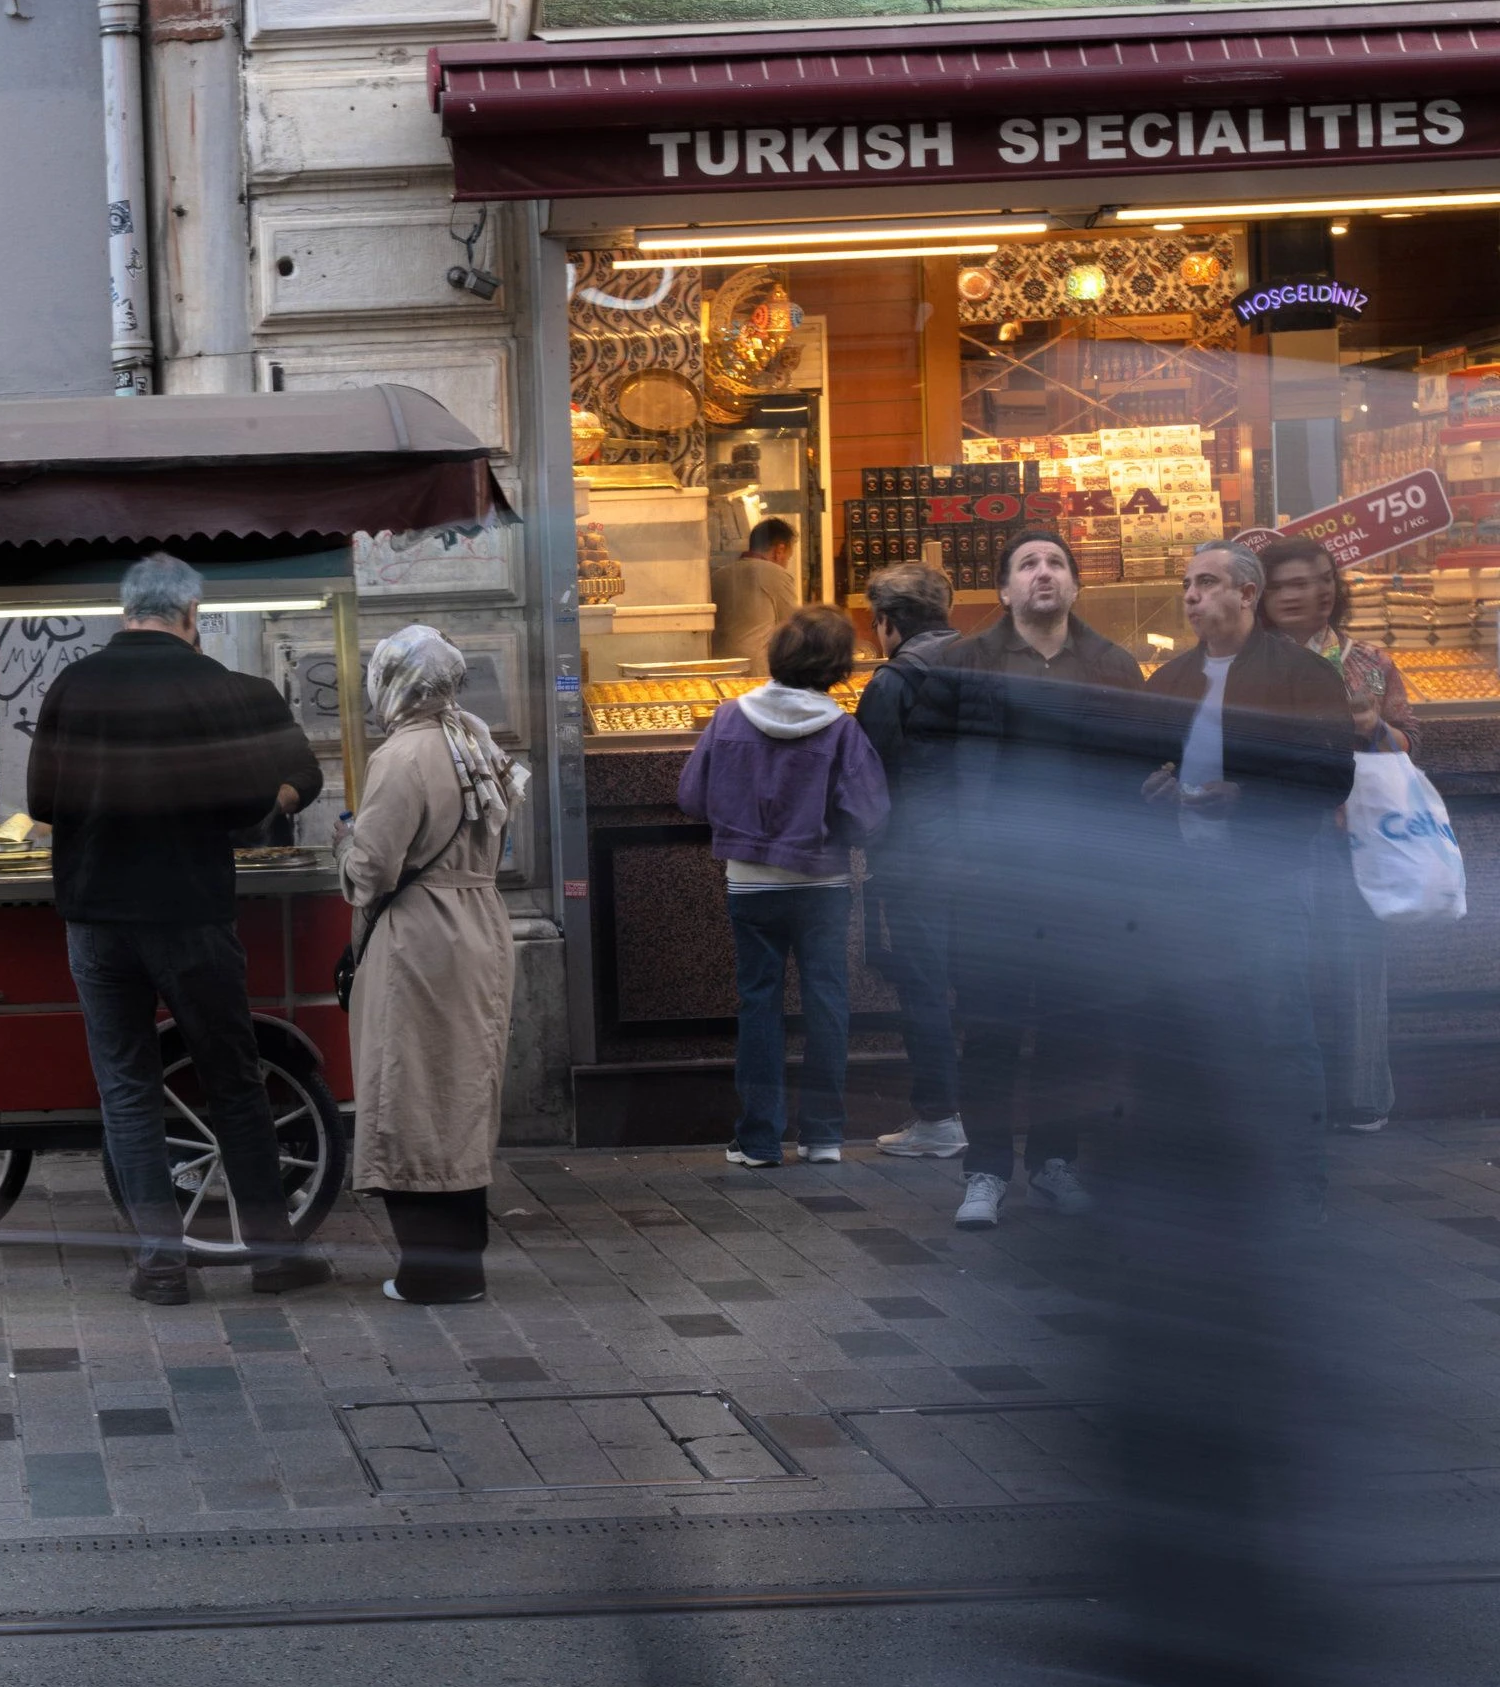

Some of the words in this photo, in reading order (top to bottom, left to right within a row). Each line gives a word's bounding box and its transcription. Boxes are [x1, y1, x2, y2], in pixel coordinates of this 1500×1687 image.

[648, 121, 955, 177] TURKISH
[997, 98, 1465, 164] SPECIALITIES
[1237, 280, 1369, 320] HOŞGELDİNİZ
[926, 487, 1169, 524] KOSKA
[1367, 485, 1427, 524] 750
[1322, 527, 1369, 552] ECIAL
[1333, 547, 1361, 566] FER
